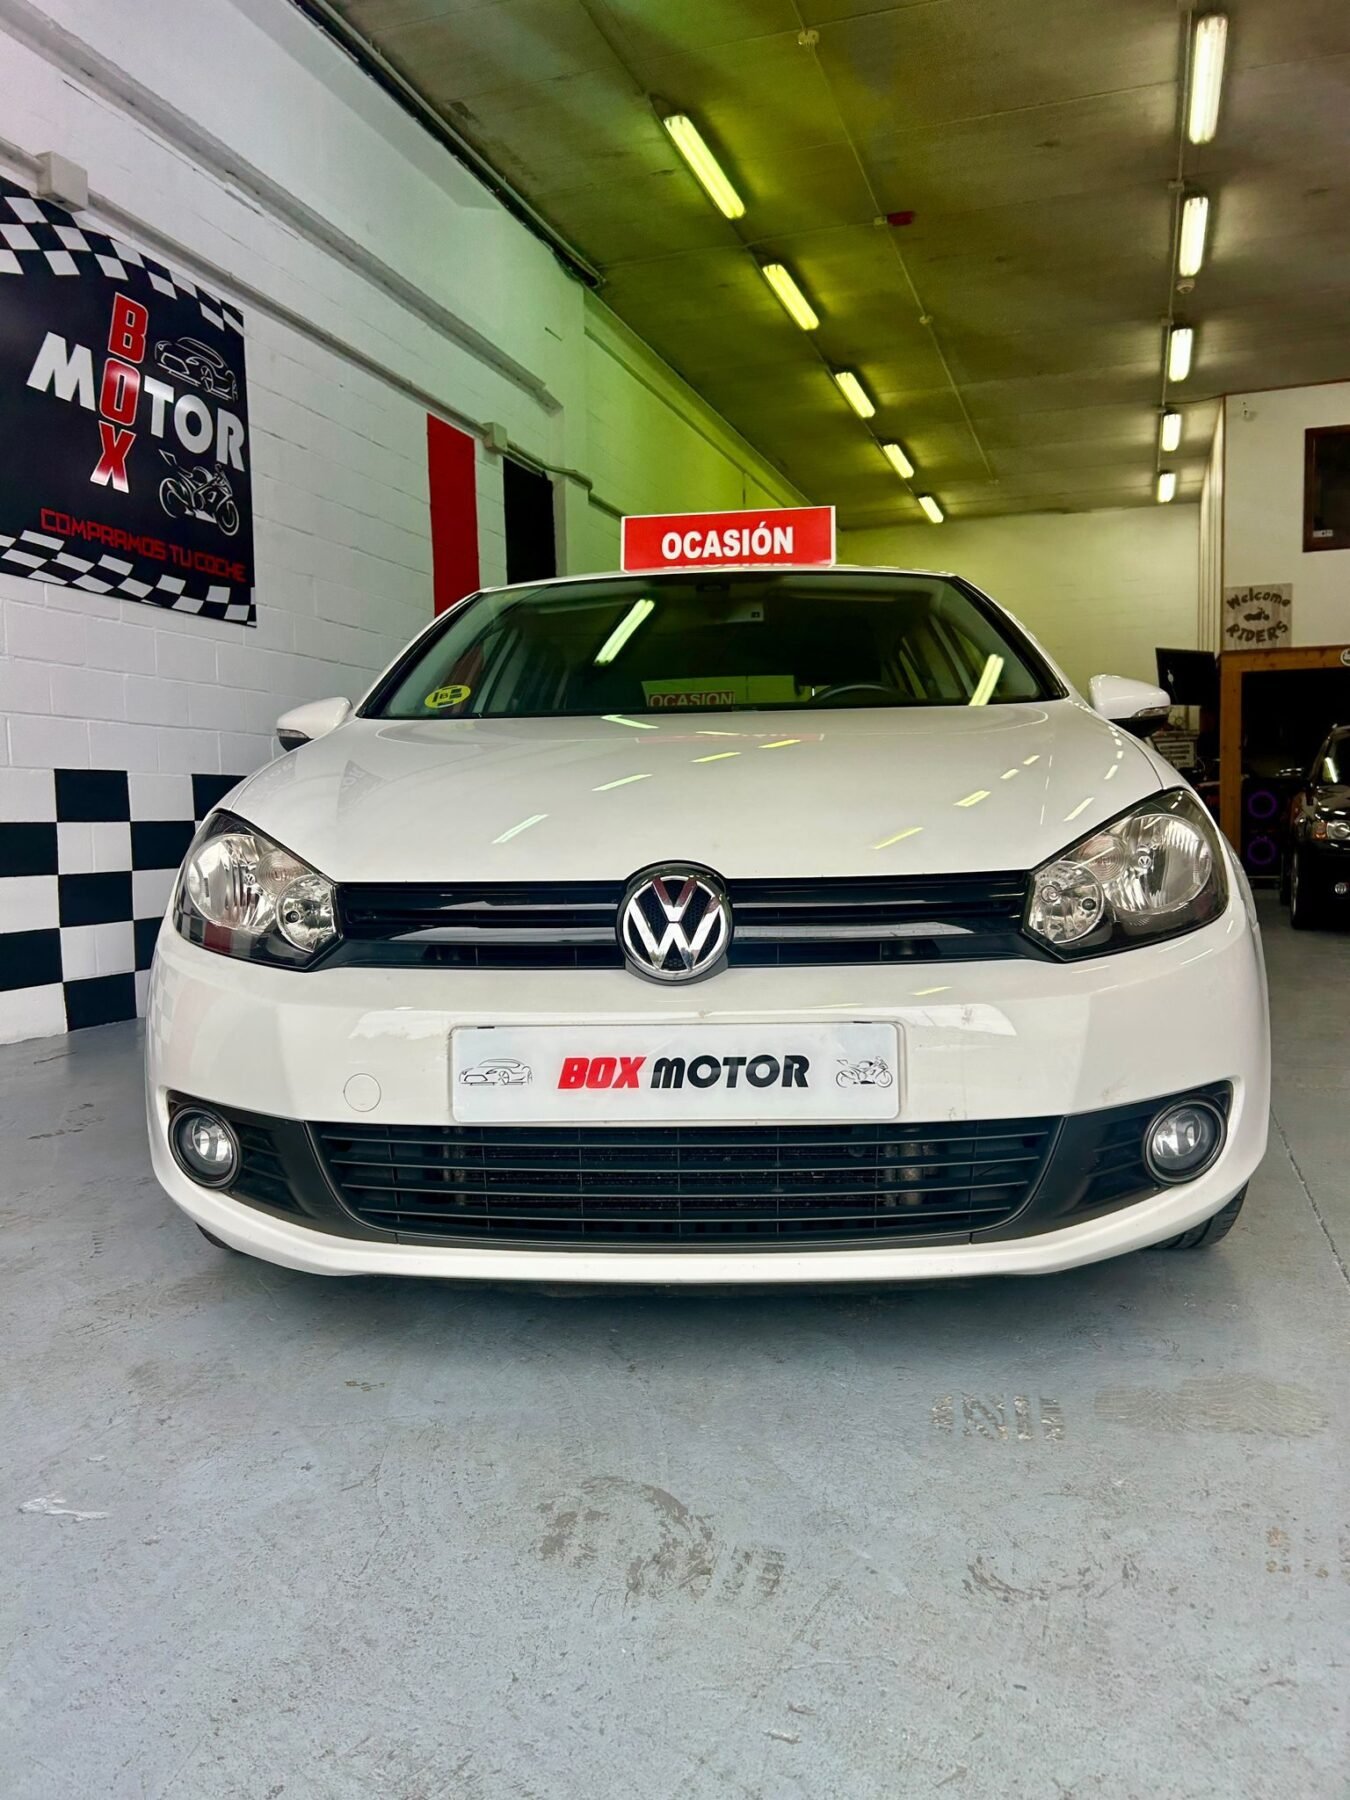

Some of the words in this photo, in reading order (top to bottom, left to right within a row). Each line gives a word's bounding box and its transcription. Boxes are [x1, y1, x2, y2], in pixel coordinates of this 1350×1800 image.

[90, 292, 149, 493] BOX
[40, 508, 166, 561] COMPRAMOS
[169, 544, 192, 568] TU
[194, 553, 246, 583] COCHE
[661, 521, 793, 560] OCASIÓN
[1226, 587, 1291, 609] Welcome
[1226, 621, 1288, 643] RIDERS
[558, 1057, 647, 1089] BOX
[650, 1055, 810, 1089] MOTOR
